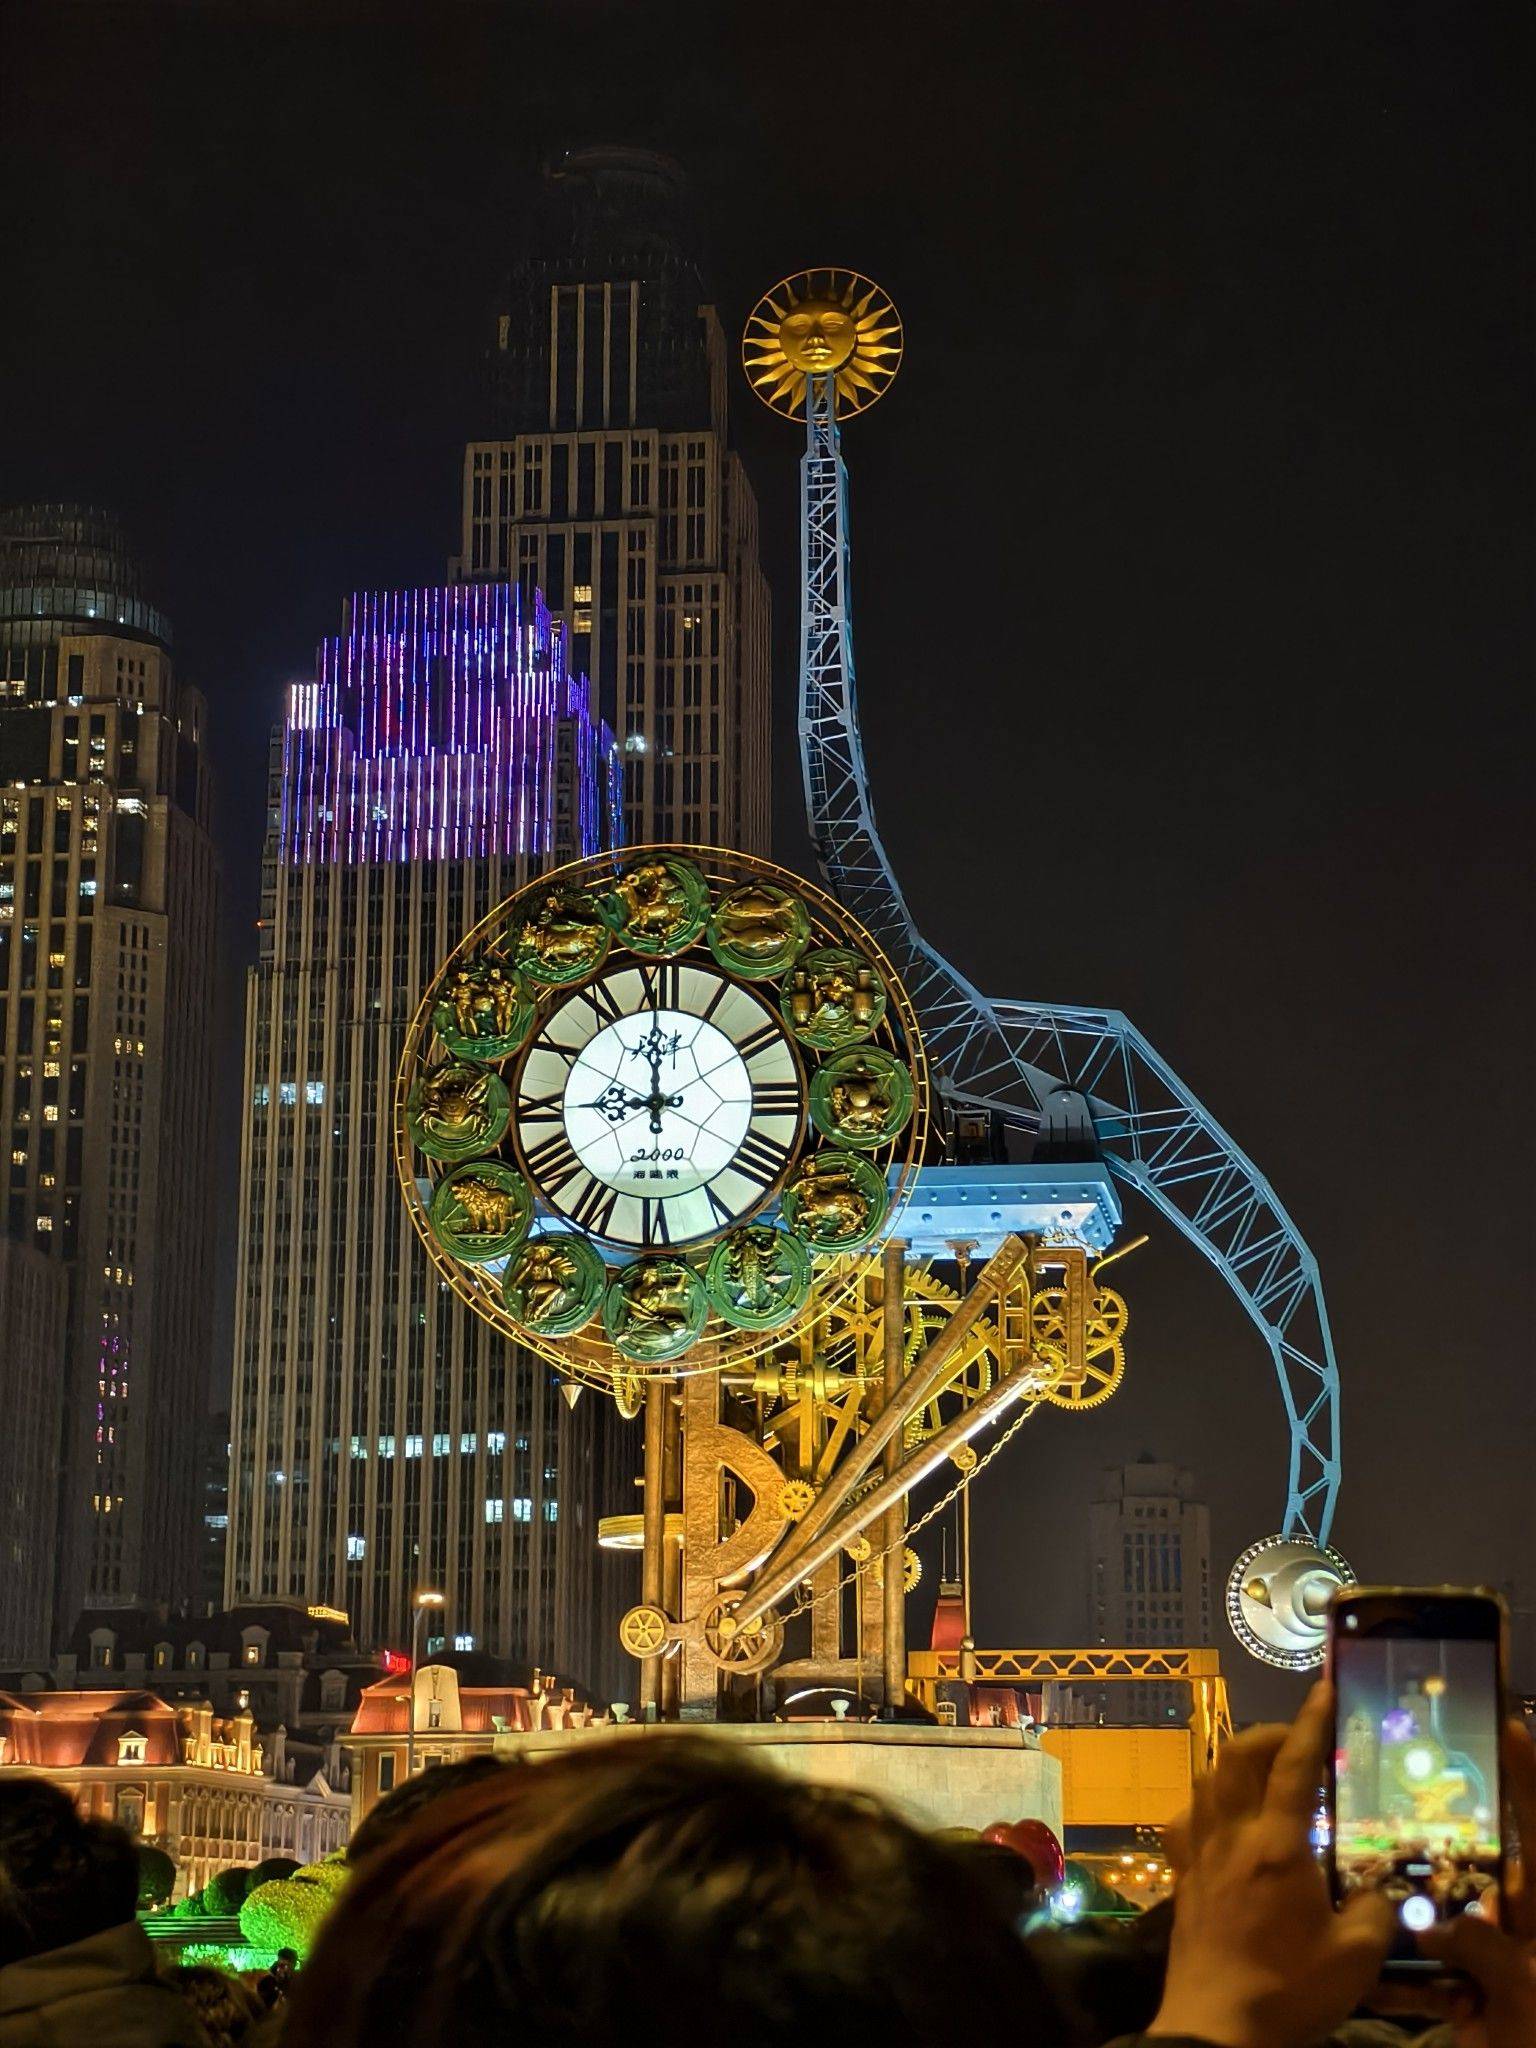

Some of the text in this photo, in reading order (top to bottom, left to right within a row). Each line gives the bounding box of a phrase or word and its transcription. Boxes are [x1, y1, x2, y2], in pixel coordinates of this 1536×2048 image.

[577, 978, 623, 1032] XI
[638, 965, 680, 1011] XII
[533, 1030, 580, 1068] X
[739, 1021, 784, 1061] II
[518, 1094, 564, 1123] IX
[752, 1082, 799, 1116] III
[630, 1148, 684, 1162] 2000
[728, 1128, 791, 1190] IIII
